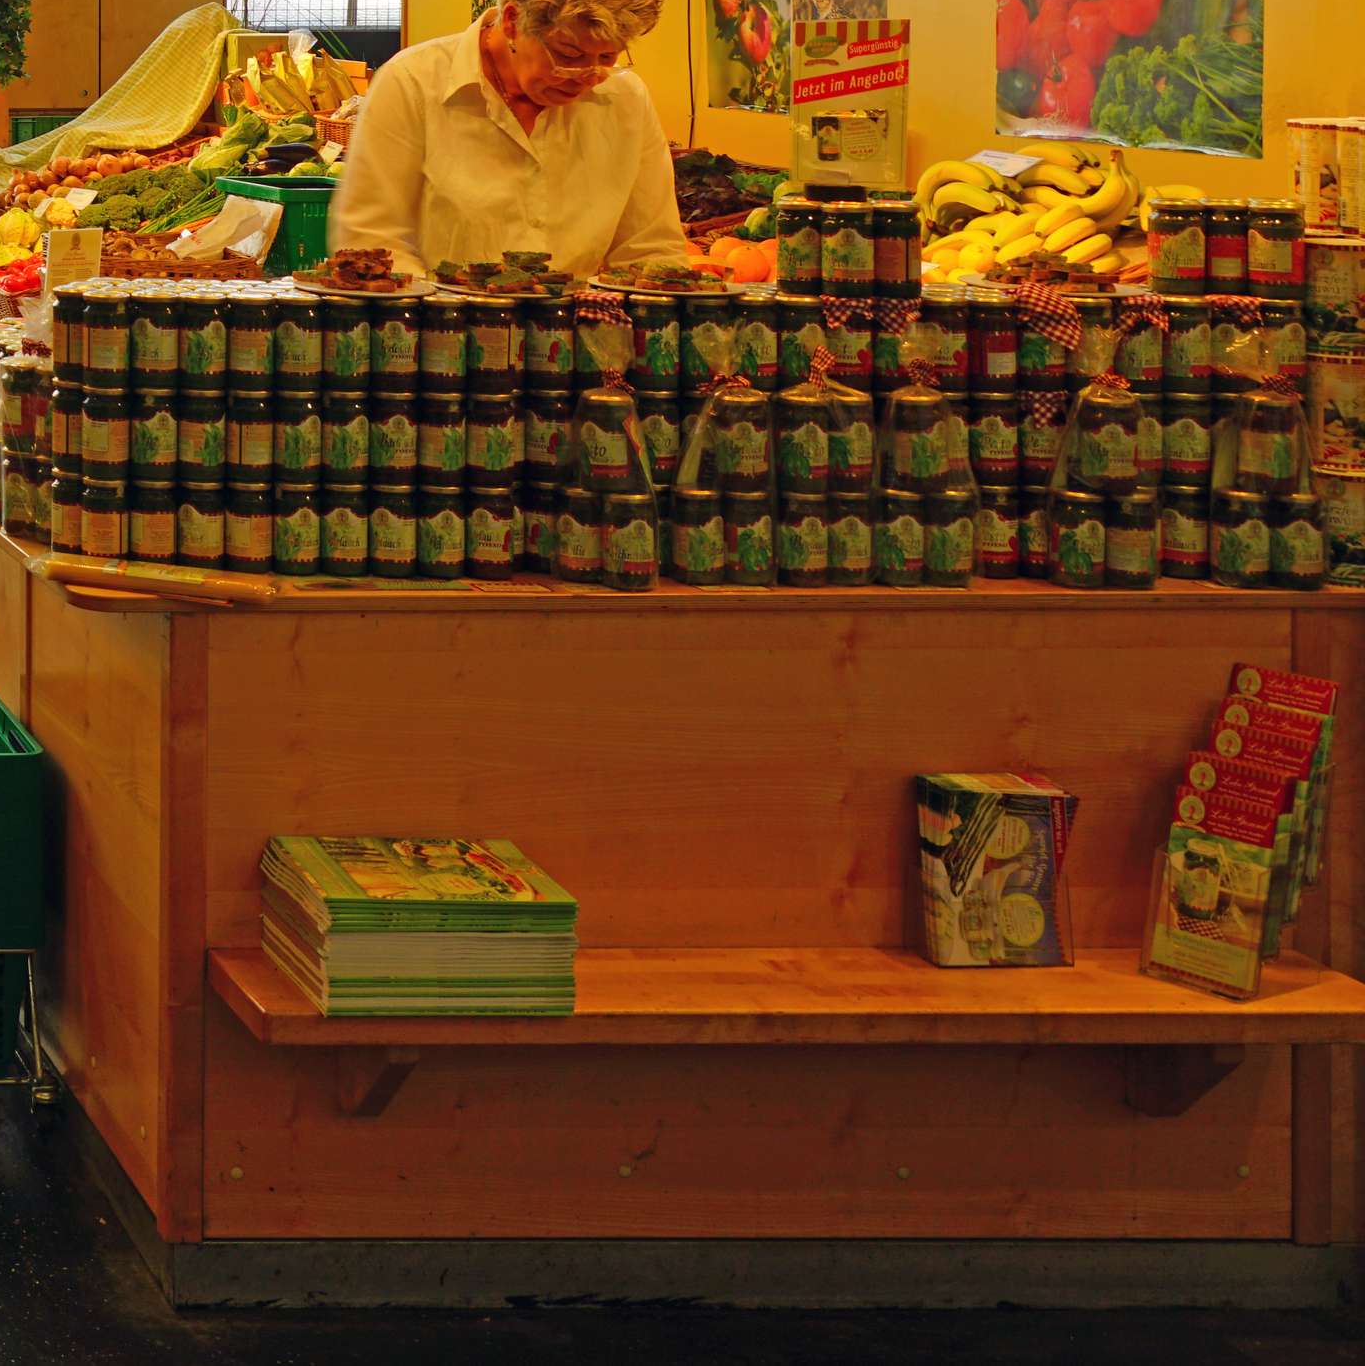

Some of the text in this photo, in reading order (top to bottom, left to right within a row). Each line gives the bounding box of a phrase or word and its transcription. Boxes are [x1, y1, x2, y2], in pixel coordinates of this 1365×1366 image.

[849, 39, 900, 55] Supergünstig
[795, 65, 905, 99] Jetzt im Angebot!
